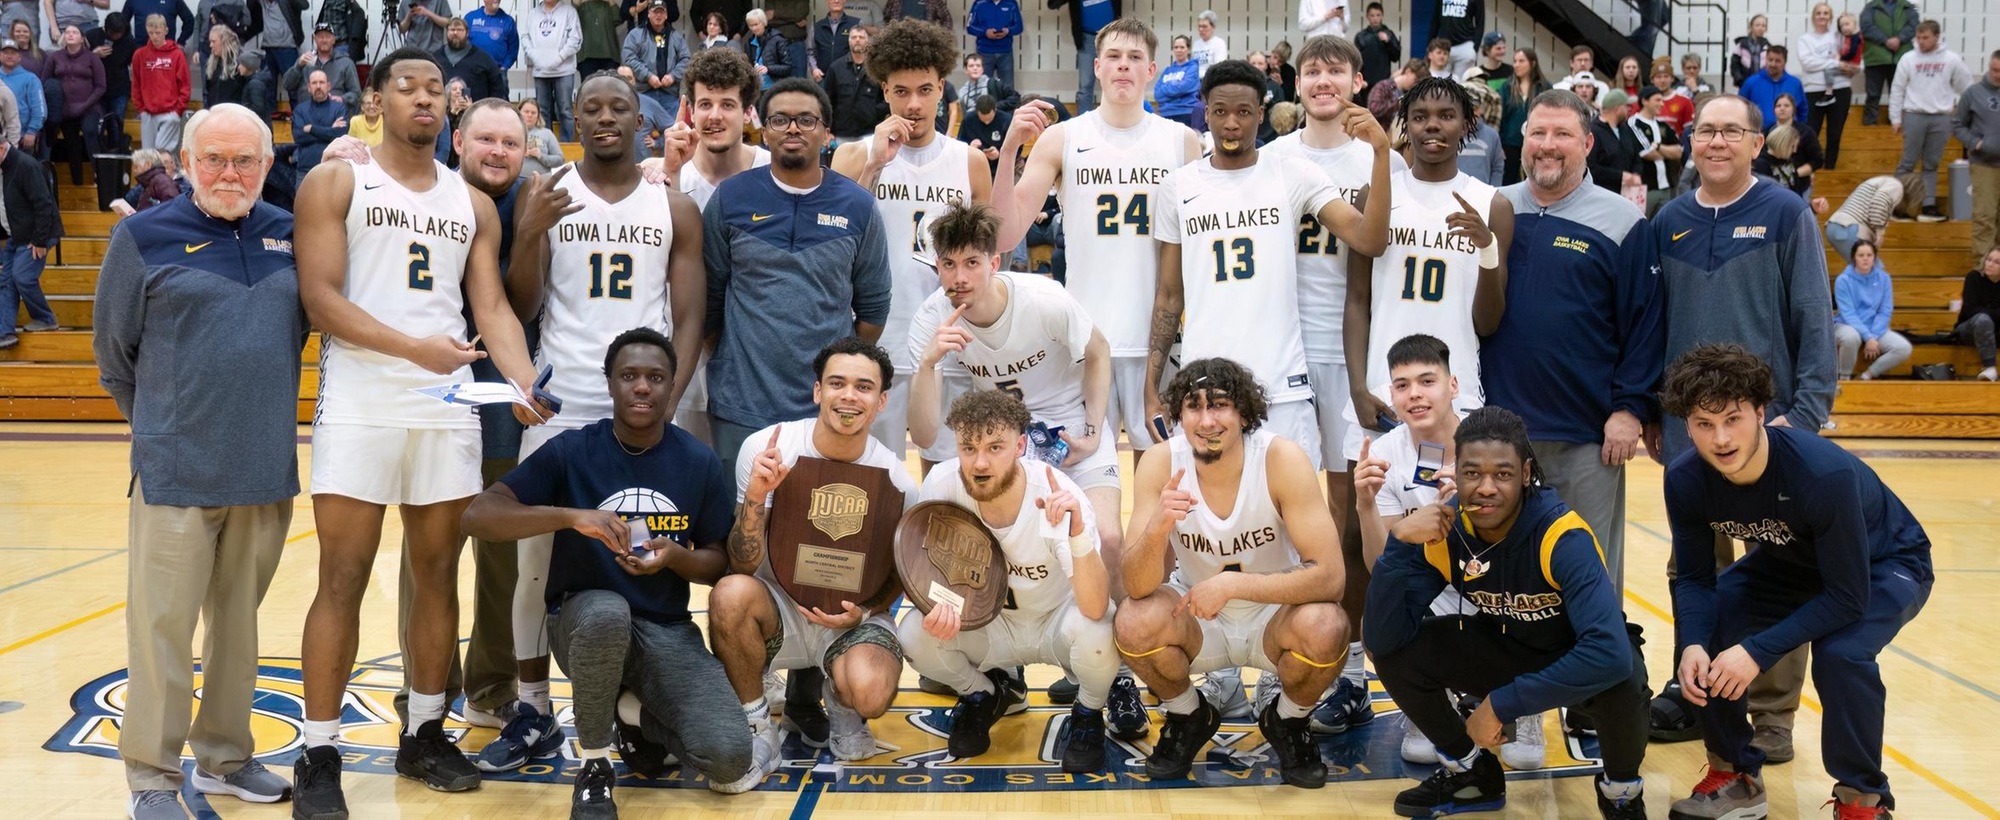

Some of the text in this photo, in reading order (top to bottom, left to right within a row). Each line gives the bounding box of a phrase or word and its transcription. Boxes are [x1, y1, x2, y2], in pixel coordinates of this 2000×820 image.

[1077, 168, 1113, 186] IOWA
[877, 183, 910, 201] OWA
[366, 206, 469, 244] IOWA LAKES
[1096, 192, 1150, 236] 24
[1185, 207, 1280, 237] IOWA LAKES
[559, 223, 663, 247] IOWA LAKES
[407, 240, 434, 292] 2
[1212, 237, 1256, 283] 13
[587, 251, 634, 301] 12
[1401, 255, 1447, 303] 10
[994, 349, 1046, 377] LAKES
[811, 491, 867, 517] NJCAA
[646, 515, 690, 531] AKES
[1218, 526, 1276, 556] LAKES
[970, 569, 981, 583] 11
[1007, 560, 1049, 581] AKES
